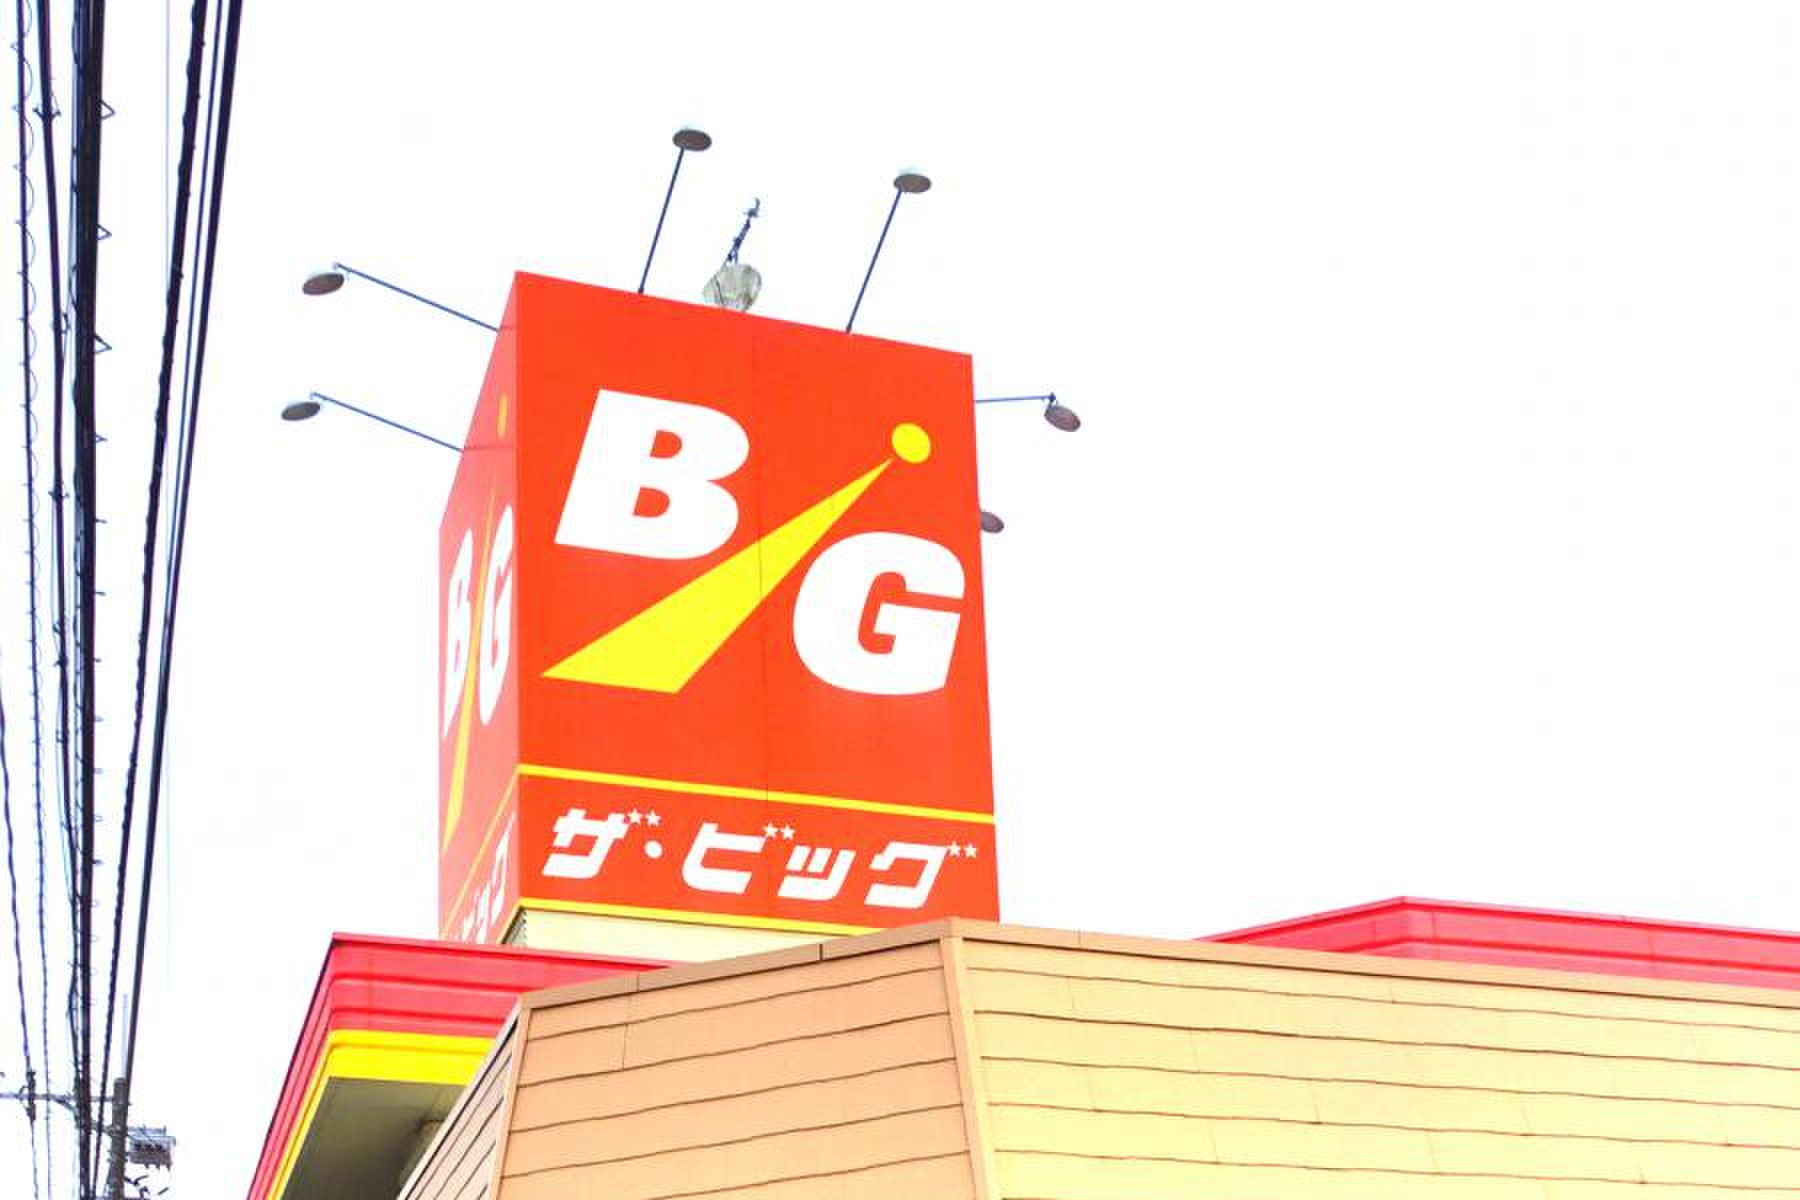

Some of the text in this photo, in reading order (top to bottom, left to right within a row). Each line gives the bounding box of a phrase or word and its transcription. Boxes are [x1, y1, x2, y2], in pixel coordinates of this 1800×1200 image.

[541, 389, 967, 696] BIG
[541, 807, 979, 909] ザ・ビッグ
